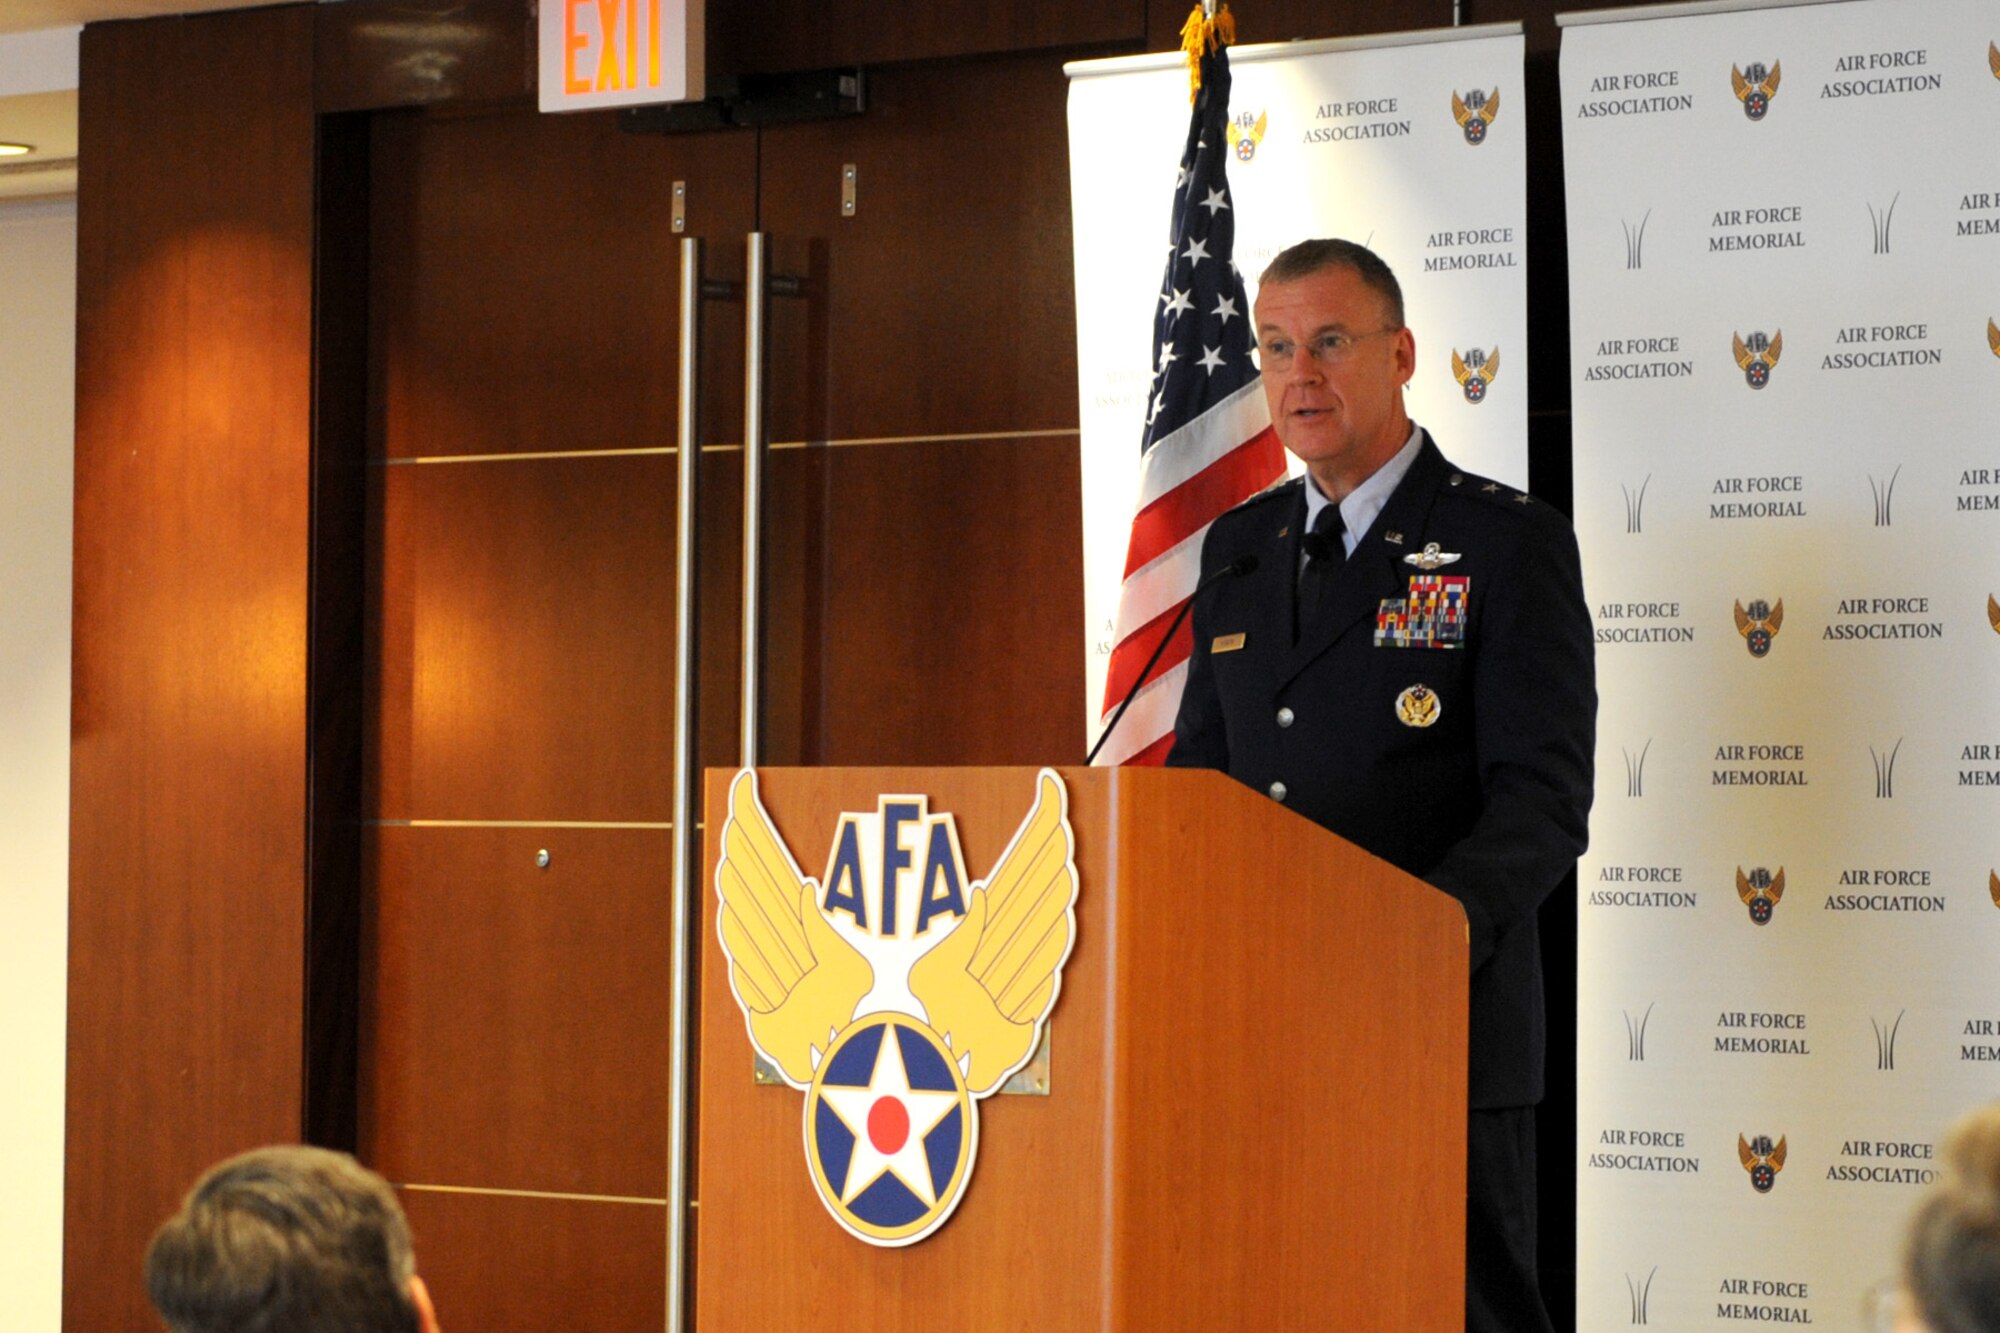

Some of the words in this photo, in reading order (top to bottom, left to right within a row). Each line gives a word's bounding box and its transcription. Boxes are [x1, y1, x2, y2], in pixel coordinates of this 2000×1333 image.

[565, 0, 660, 95] EXIT
[1835, 55, 1866, 72] AIR
[1870, 50, 1927, 69] FORCE
[1591, 76, 1621, 92] AIR
[1623, 71, 1678, 90] FORCE
[1821, 74, 1941, 98] ASSOCIATION
[1316, 103, 1343, 119] AIR
[1347, 98, 1397, 116] FORCE
[1578, 95, 1692, 118] ASSOCIATION
[1304, 121, 1411, 143] ASSOCIATION
[1960, 193, 1991, 210] AIR
[1712, 211, 1742, 227] AIR
[1745, 207, 1801, 224] FORCE
[1427, 232, 1454, 248] AIR
[1458, 228, 1513, 245] FORCE
[1709, 232, 1805, 252] MEMORIAL
[1424, 252, 1517, 272] MEMORIAL
[1836, 327, 1867, 343] AIR
[1871, 324, 1927, 342] FORCE
[1597, 340, 1624, 356] AIR
[1627, 337, 1679, 354] FORCE
[1821, 349, 1941, 369] ASSOCIATION
[1585, 361, 1693, 381] ASSOCIATION
[1713, 478, 1744, 494] AIR
[1747, 476, 1802, 493] FORCE
[1960, 469, 1990, 485] AIR
[1710, 501, 1806, 519] MEMORIAL
[1598, 604, 1624, 619] AIR
[1627, 603, 1679, 618] FORCE
[1837, 599, 1869, 614] AIR
[1872, 598, 1928, 614] FORCE
[1595, 627, 1694, 643] SSOCIATION
[1823, 623, 1943, 640] ASSOCIATION
[1715, 745, 1745, 760] AIR
[1749, 745, 1804, 760] FORCE
[1961, 745, 1991, 760] AIR
[1712, 770, 1808, 785] MEMORIAL
[822, 801, 967, 938] AFA
[1600, 867, 1625, 881] AIR
[1628, 867, 1682, 882] FORCE
[1839, 870, 1870, 885] AIR
[1874, 870, 1931, 886] FORCE
[1589, 891, 1696, 907] ASSOCIATION
[1824, 895, 1945, 911] ASSOCIATION
[1717, 1012, 1747, 1028] AIR
[1750, 1013, 1806, 1029] FORCE
[1964, 1020, 1994, 1035] AIR
[1714, 1037, 1810, 1054] MEMORIAL
[1600, 1130, 1626, 1145] AIR
[1630, 1131, 1684, 1147] FORCE
[1841, 1141, 1872, 1156] AIR
[1876, 1142, 1932, 1159] FORCE
[1589, 1154, 1699, 1172] ASSOCIATION
[1720, 1279, 1749, 1295] AIR
[1753, 1280, 1807, 1298] FORCE
[1717, 1303, 1812, 1324] MEMORIAL
